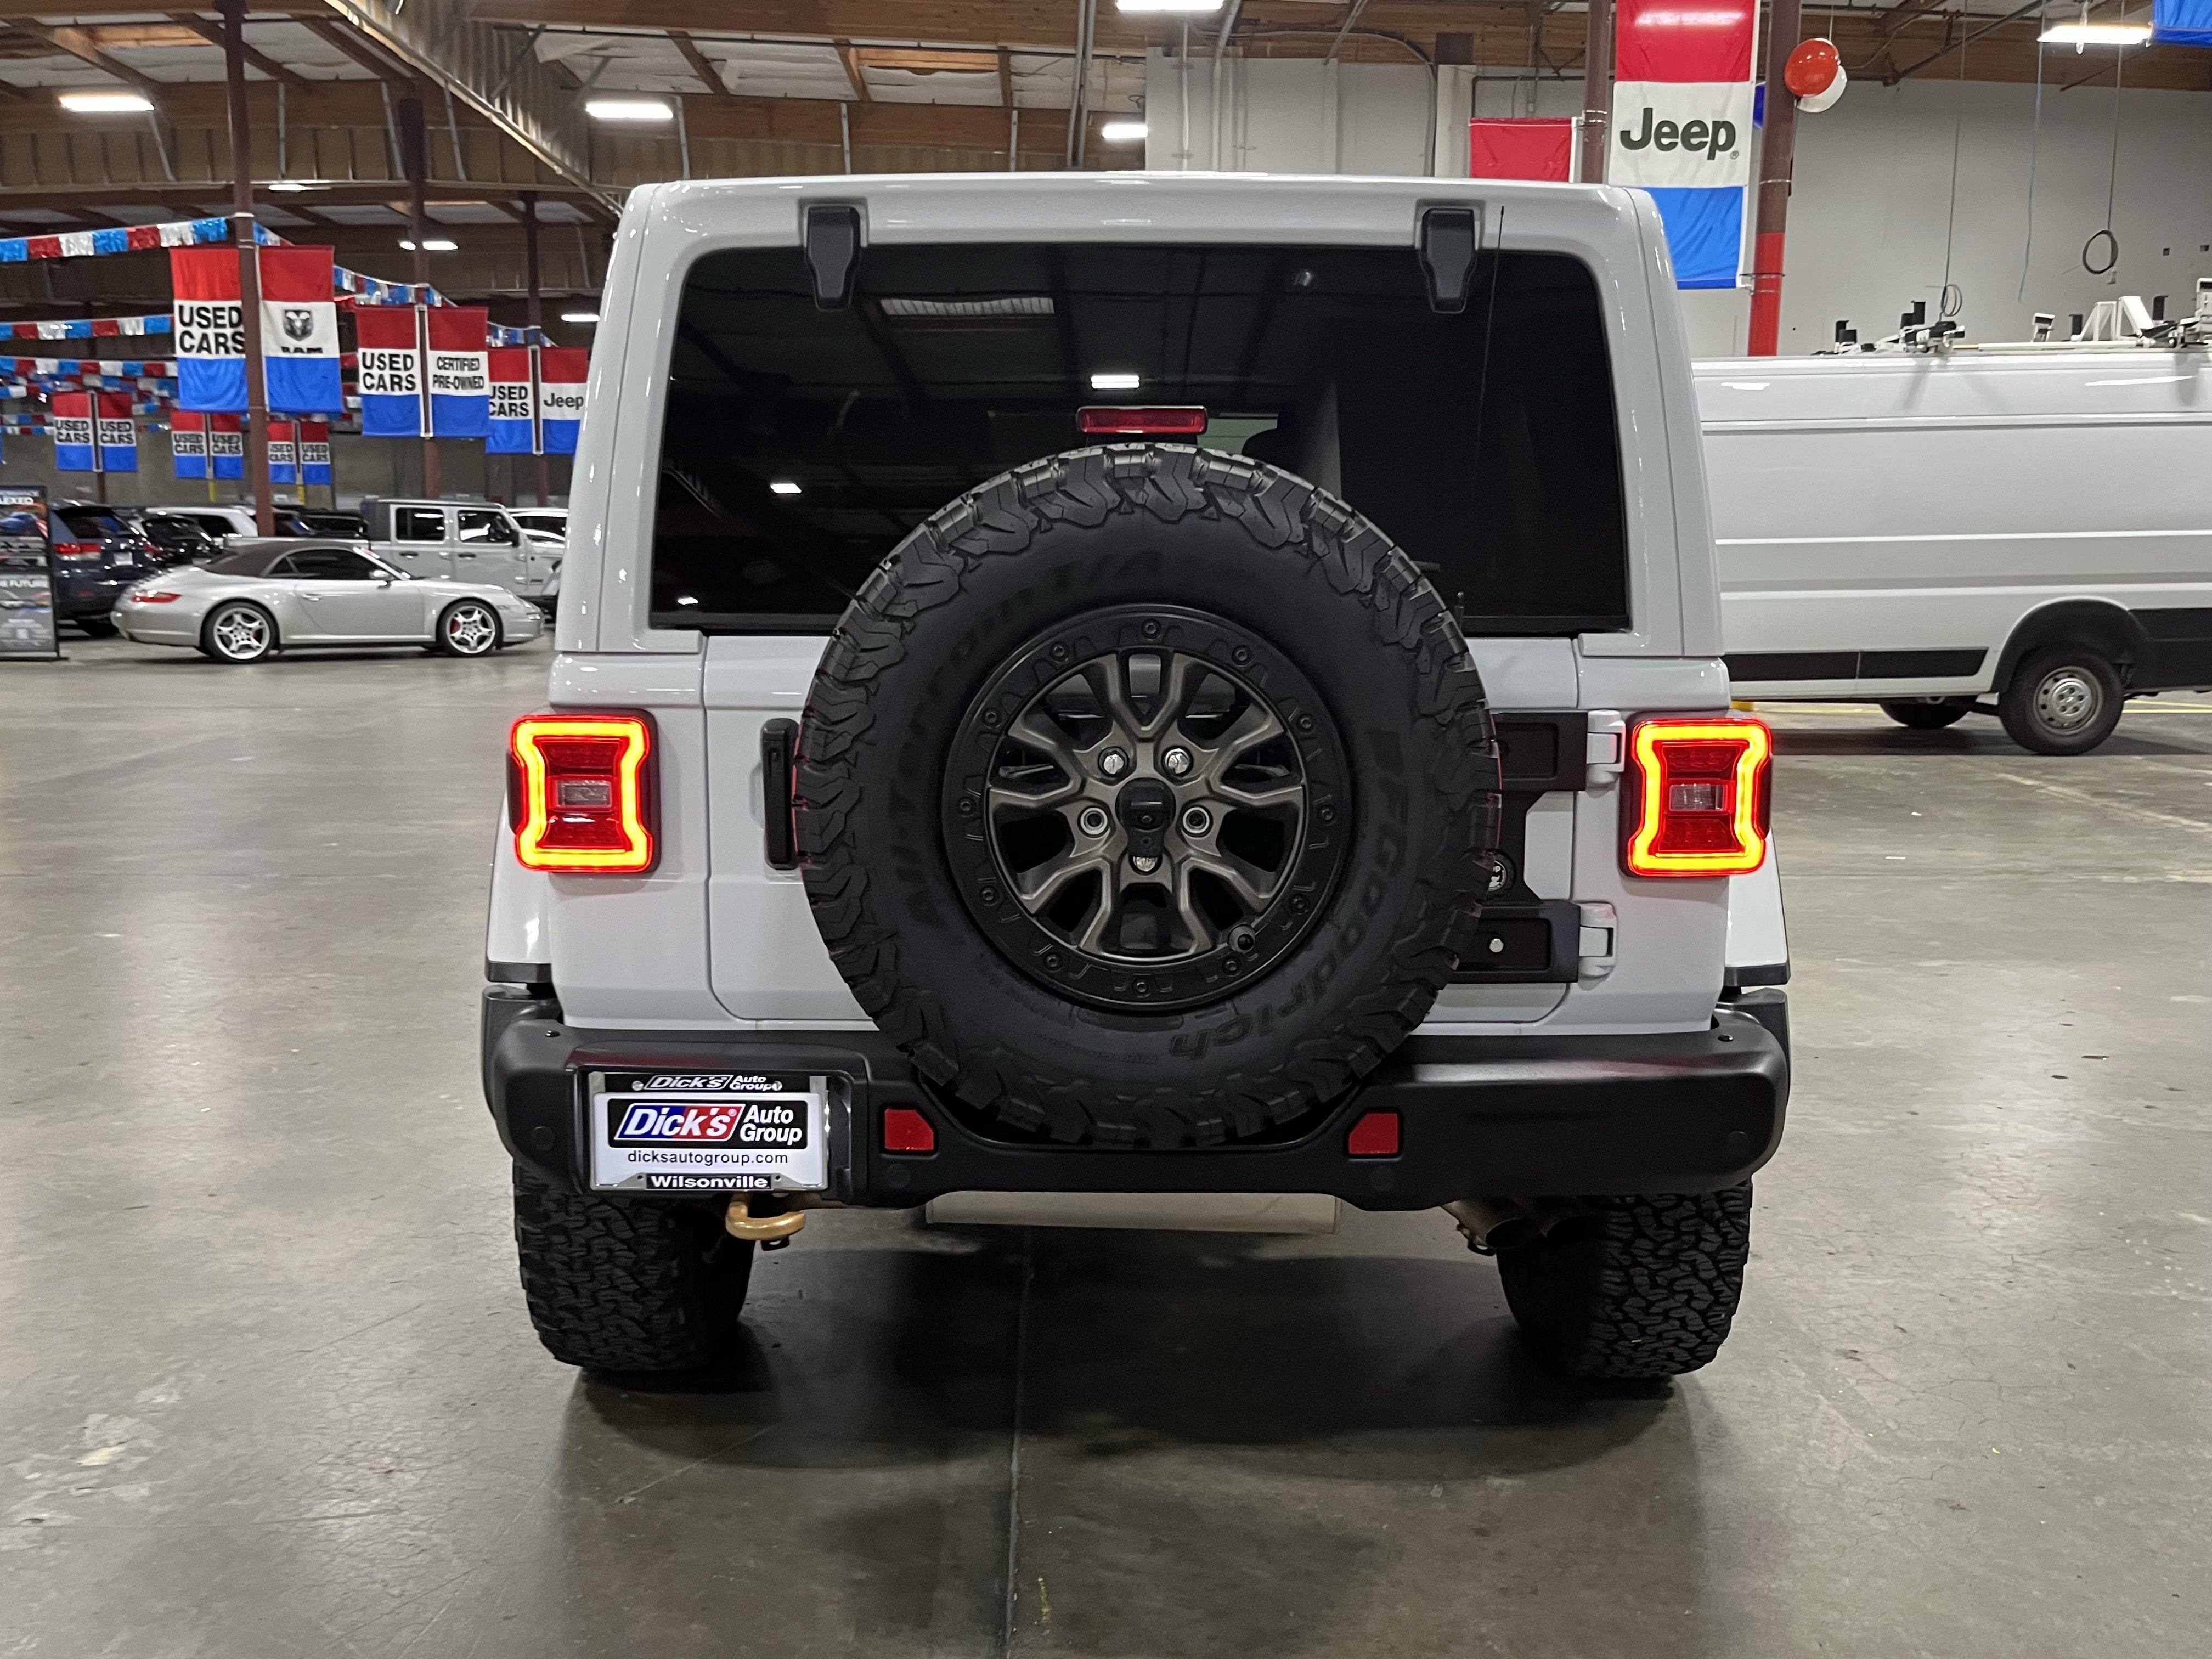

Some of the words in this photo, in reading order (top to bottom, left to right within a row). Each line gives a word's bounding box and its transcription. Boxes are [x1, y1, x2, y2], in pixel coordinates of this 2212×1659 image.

[1620, 107, 1736, 160] Jeep
[178, 305, 242, 329] USED
[179, 330, 245, 354] CARS
[362, 352, 414, 371] USED
[437, 357, 480, 371] CERTIFIED
[363, 373, 416, 391] CARS
[433, 375, 484, 390] PRE-OWNED
[544, 393, 584, 410] Jeep
[55, 420, 89, 431] USED
[100, 421, 132, 432] USED
[57, 432, 90, 443] CARS
[100, 433, 133, 444] CARS
[176, 444, 204, 454] CARS
[213, 444, 241, 454] CARS
[650, 1075, 725, 1088] Dick's
[734, 1075, 766, 1084] Auto
[743, 1104, 794, 1124] Auto
[624, 1107, 731, 1137] Dick's
[740, 1124, 803, 1146] Group
[628, 1150, 788, 1166] dicksautogroup.com
[651, 1176, 768, 1188] Wilsonville
